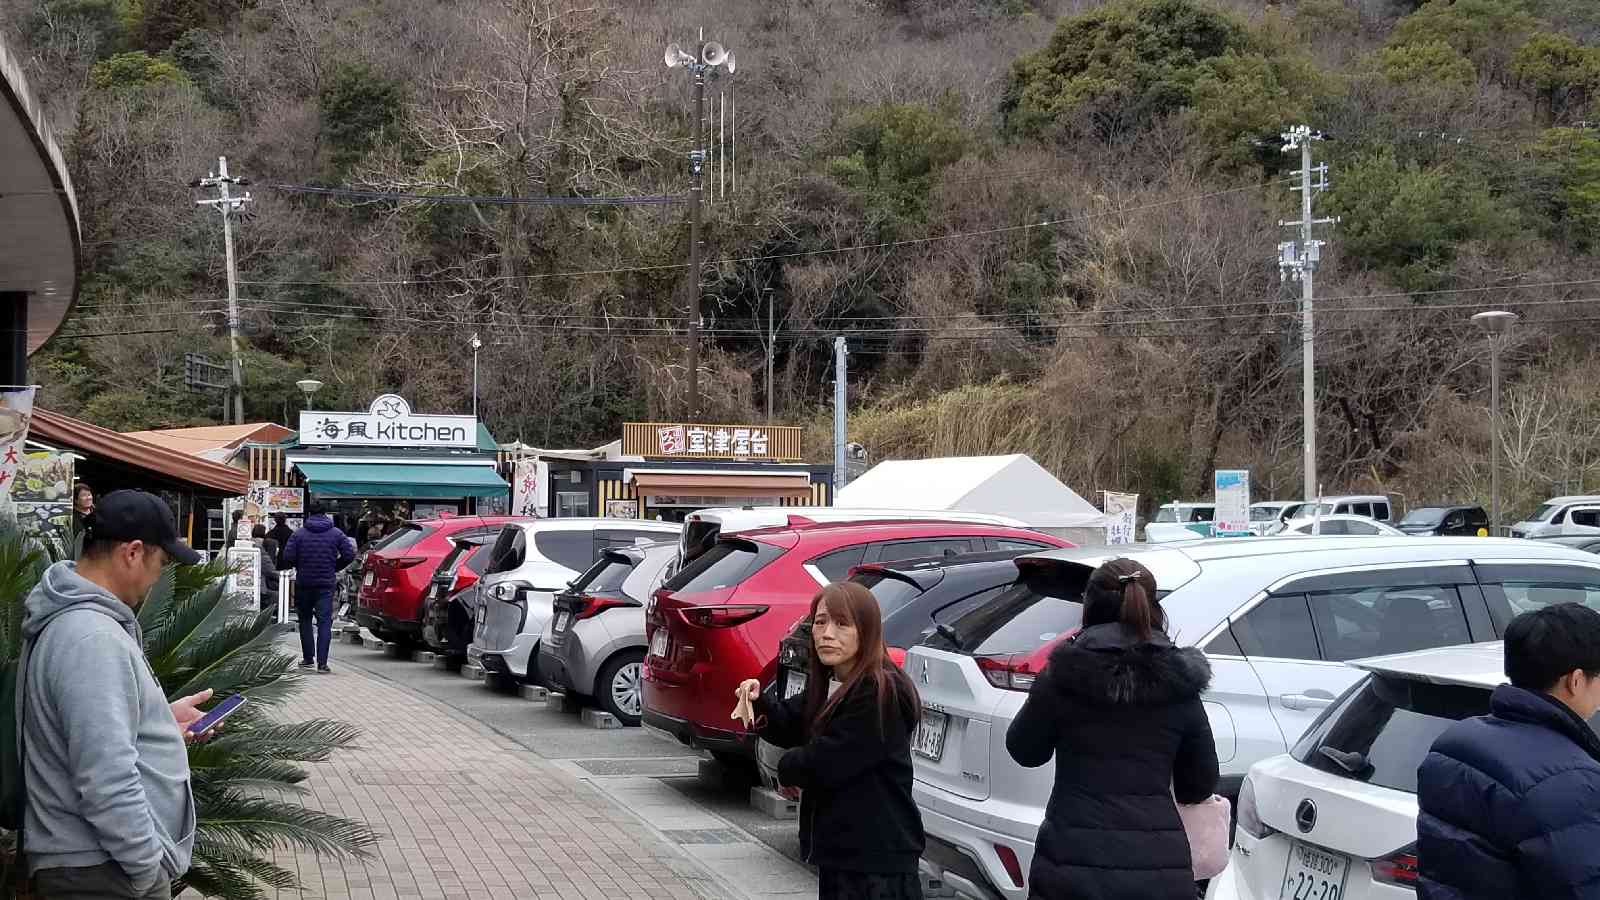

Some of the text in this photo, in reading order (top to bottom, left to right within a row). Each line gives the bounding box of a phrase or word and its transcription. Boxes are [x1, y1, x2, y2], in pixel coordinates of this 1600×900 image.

[316, 417, 373, 439] 海風
[687, 426, 768, 454] 室津屋台
